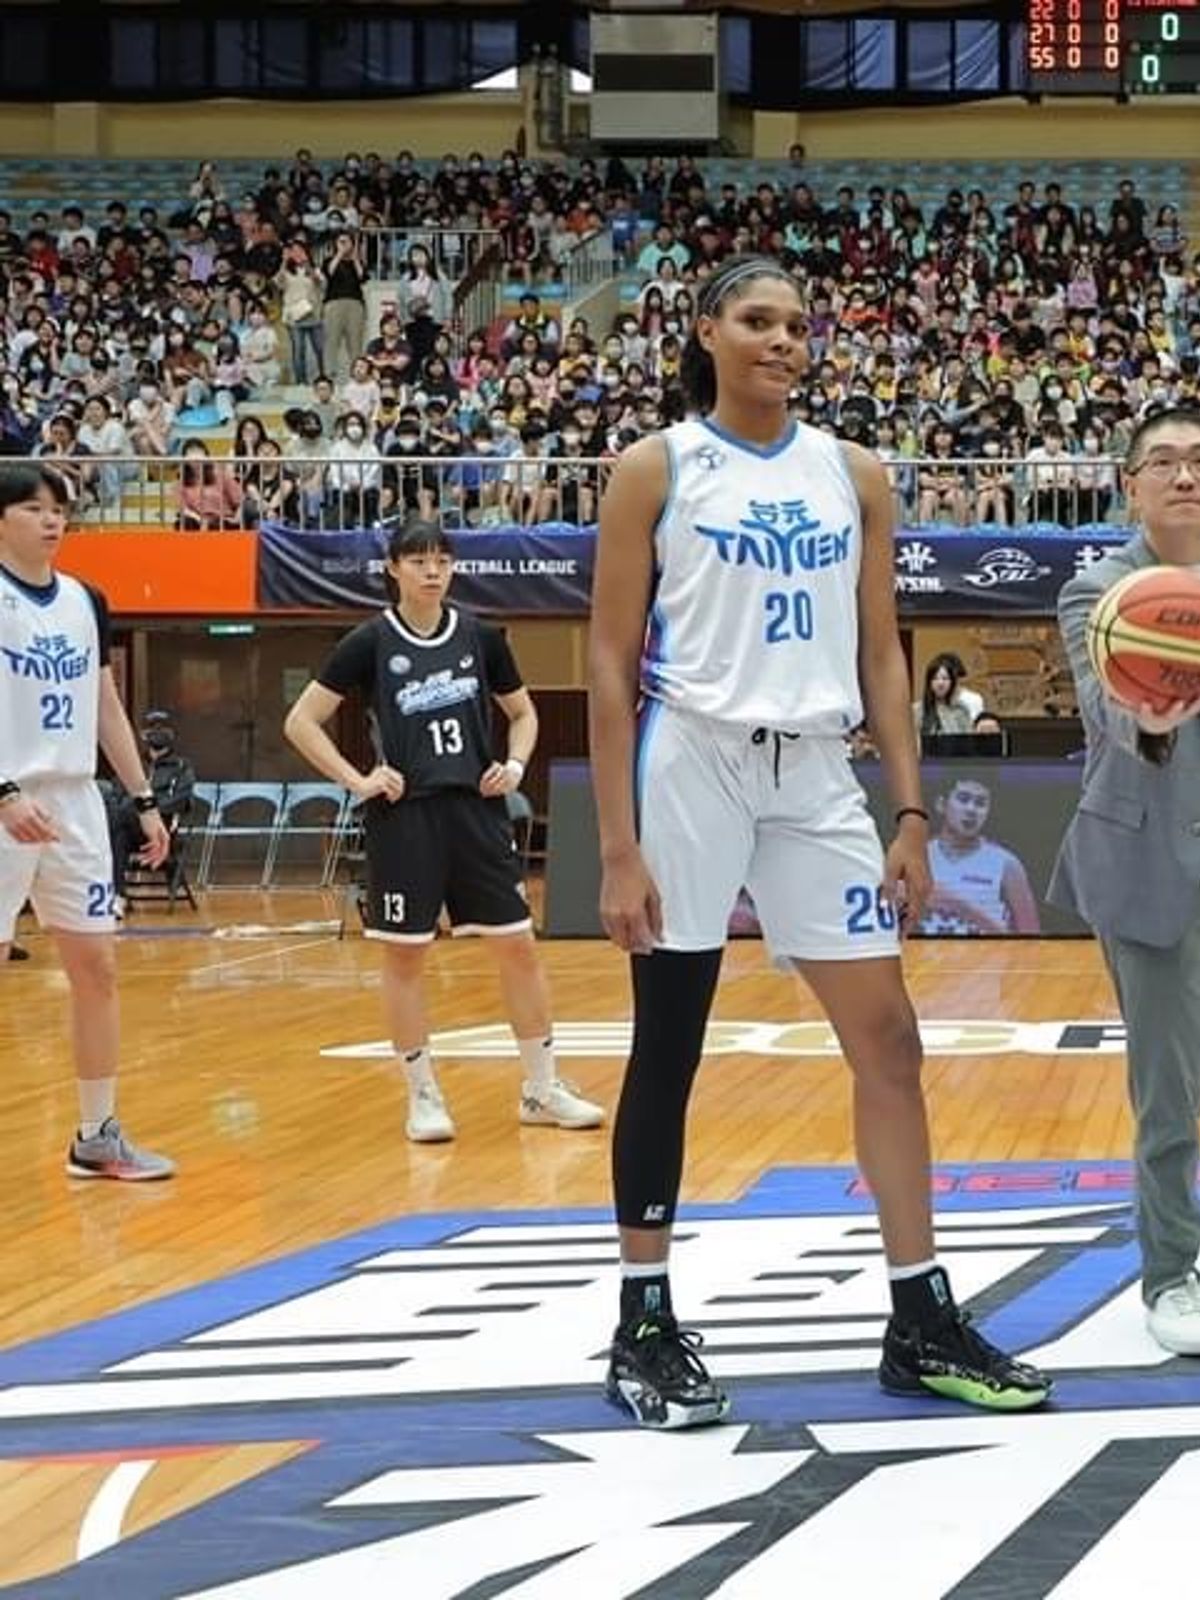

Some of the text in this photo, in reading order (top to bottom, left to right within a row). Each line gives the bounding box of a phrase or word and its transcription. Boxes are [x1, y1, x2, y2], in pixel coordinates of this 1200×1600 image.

[1067, 22, 1081, 43] 0
[1105, 22, 1119, 43] 0
[1161, 13, 1179, 41] 0
[1030, 47, 1119, 68] 55 0 0
[1142, 54, 1159, 82] 0
[765, 590, 813, 643] 20
[427, 717, 463, 756] 13
[384, 892, 405, 923] 13
